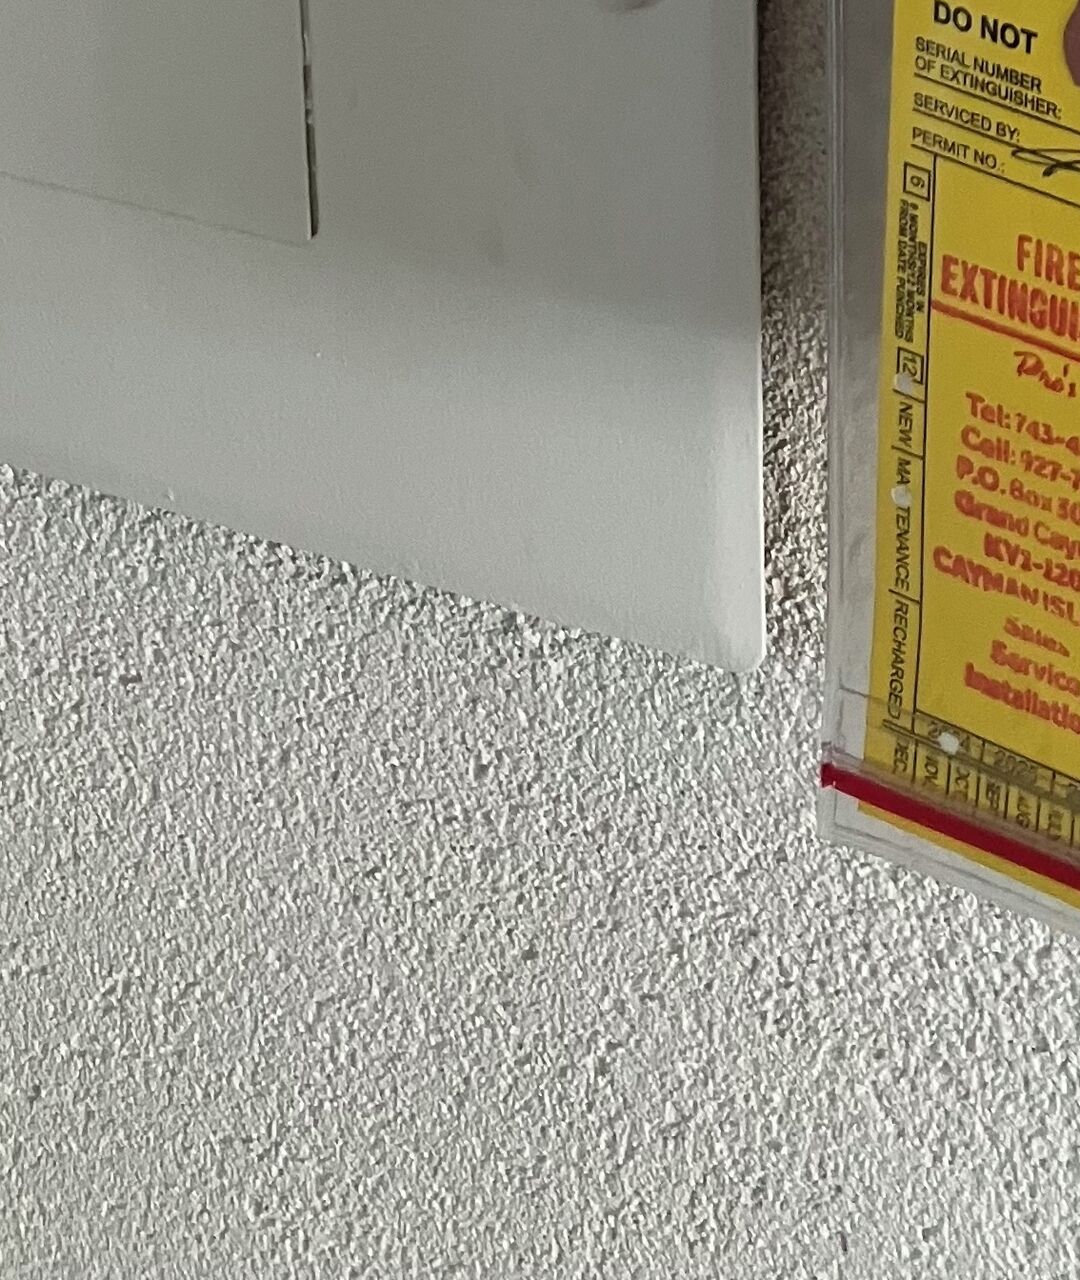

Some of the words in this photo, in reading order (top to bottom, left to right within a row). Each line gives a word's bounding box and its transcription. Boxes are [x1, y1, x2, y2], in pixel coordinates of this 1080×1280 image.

[980, 13, 1038, 54] NOT
[914, 54, 938, 73] OF
[939, 62, 1062, 120] EXTINGUISHER:
[915, 36, 970, 68] SERIAL
[972, 55, 1042, 93] NUMBER
[911, 126, 970, 162] PERMIT
[913, 91, 992, 131] SERVICED
[994, 120, 1021, 144] BY:
[897, 240, 907, 274] DATE
[895, 276, 906, 339] PUNCHED
[902, 353, 918, 379] 12
[897, 402, 914, 448] NEW
[965, 392, 1011, 430] Tel:
[956, 455, 1008, 497] P.O.
[1009, 476, 1054, 512] Box
[894, 459, 914, 593] MATENANCE
[954, 488, 1029, 537] Grand
[932, 545, 1040, 605] CAYMAN
[885, 604, 910, 720] RECHARGED
